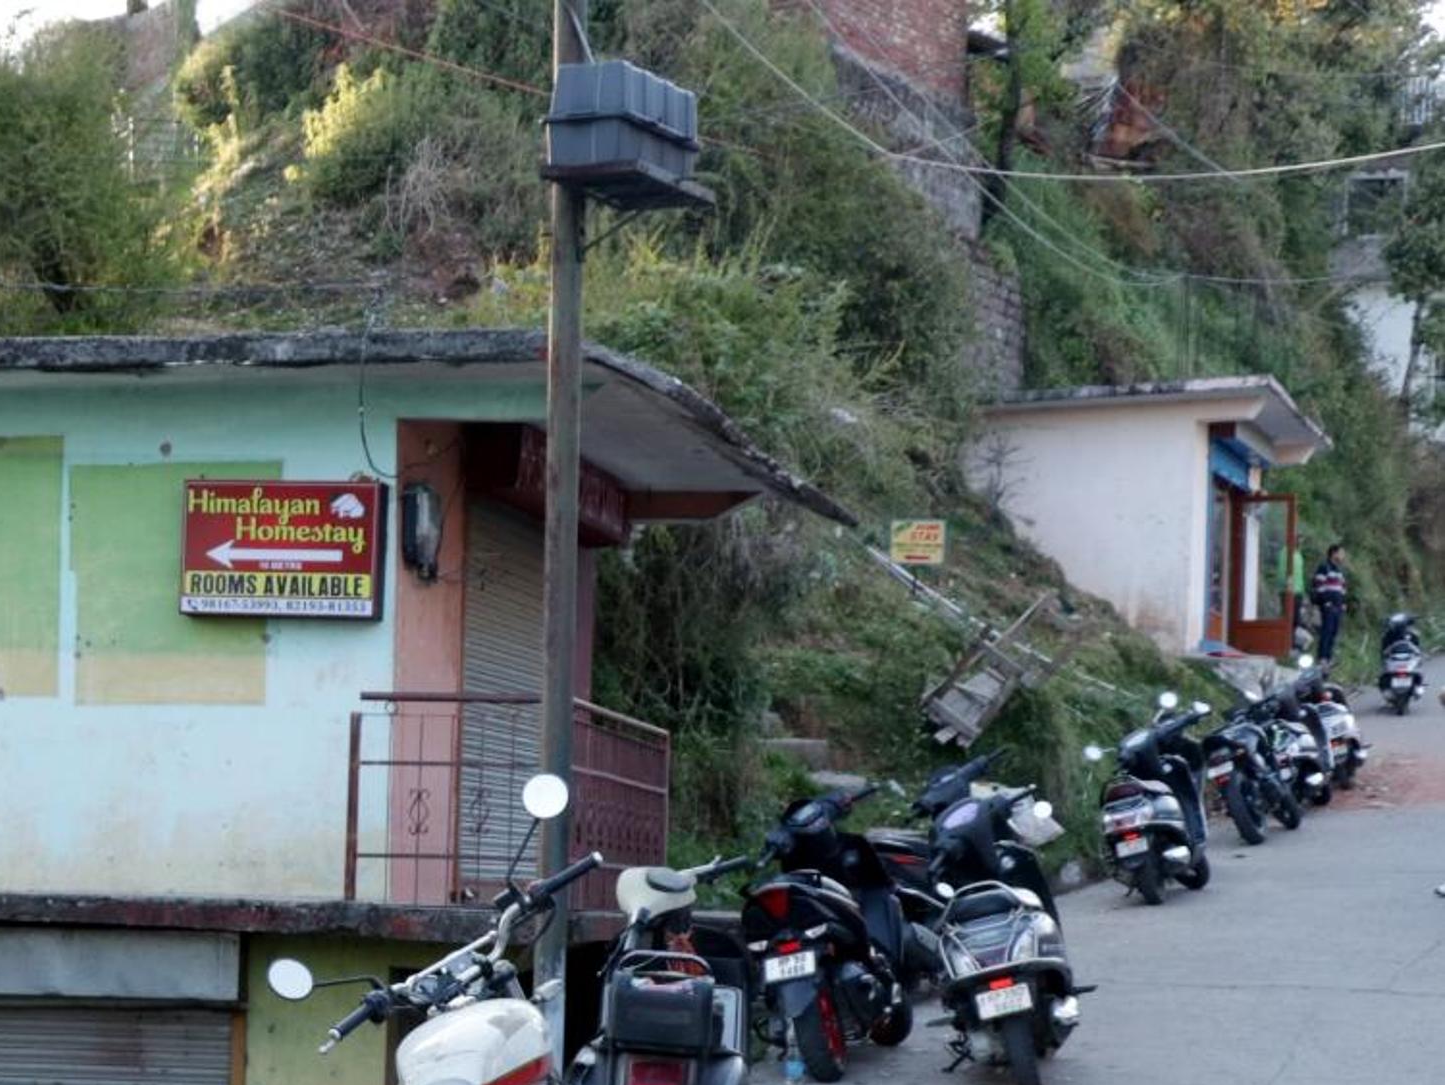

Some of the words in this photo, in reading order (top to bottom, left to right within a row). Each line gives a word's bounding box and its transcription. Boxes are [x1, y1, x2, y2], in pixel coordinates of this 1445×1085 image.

[188, 487, 321, 524] Himalayan
[235, 516, 366, 553] Homestay
[190, 574, 257, 595] ROOMS
[262, 575, 363, 597] AVAILABLE
